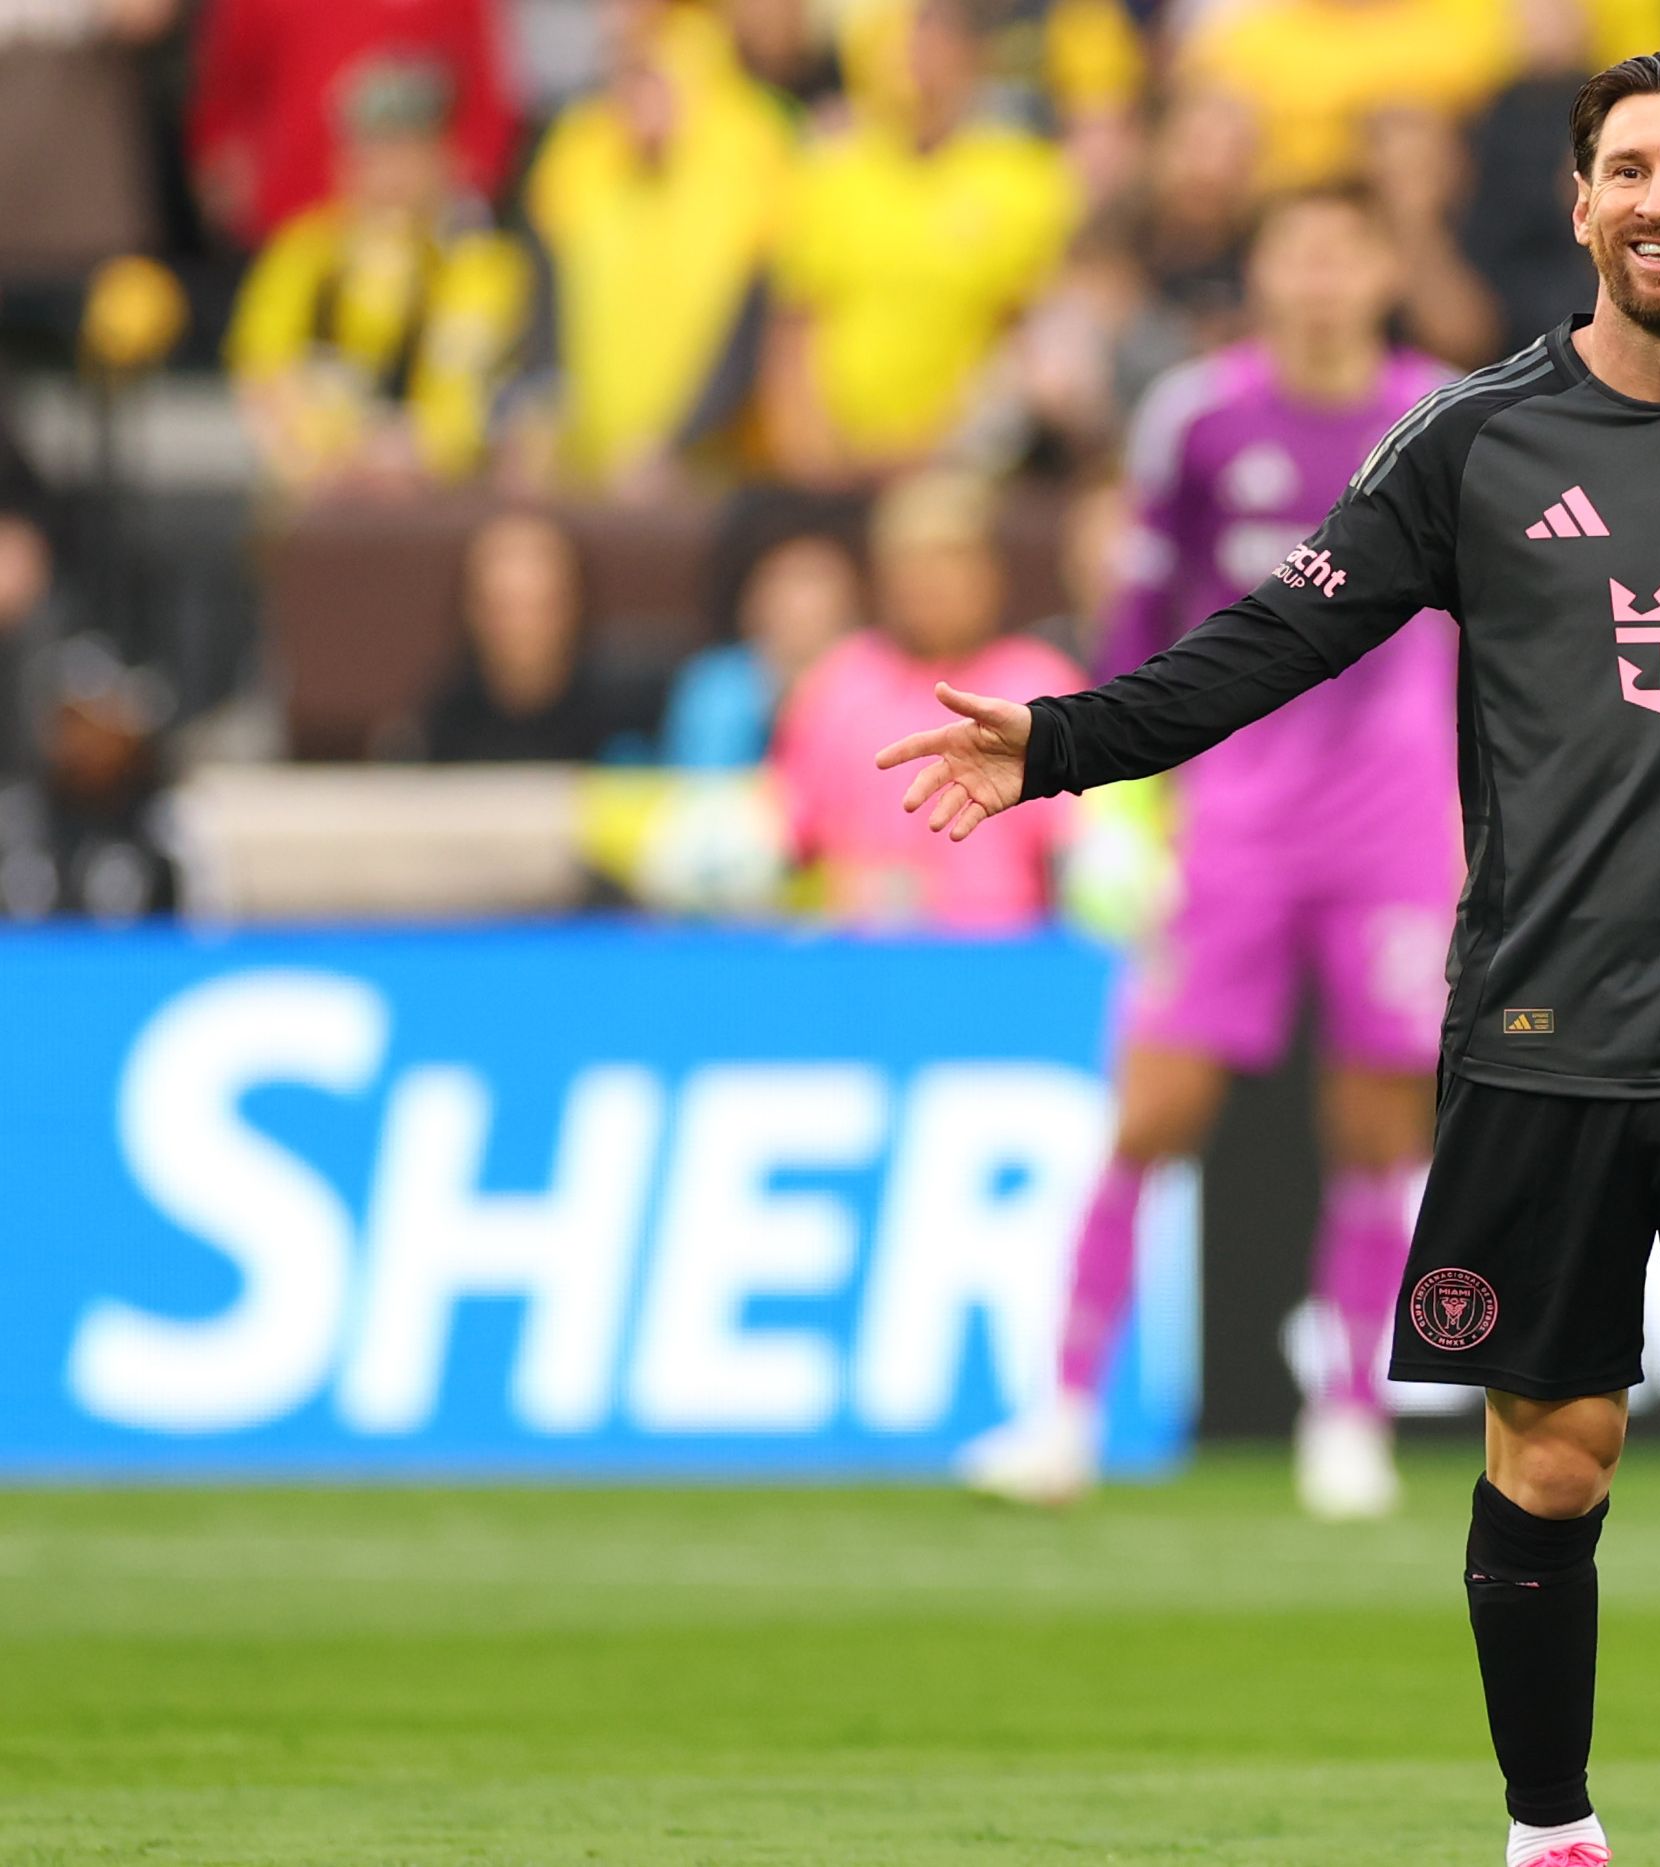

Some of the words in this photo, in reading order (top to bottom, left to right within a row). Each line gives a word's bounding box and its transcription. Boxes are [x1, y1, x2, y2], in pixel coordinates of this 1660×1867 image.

[1272, 563, 1305, 588] OUP
[66, 966, 1200, 1434] SHER
[1438, 1288, 1471, 1296] MIAMI
